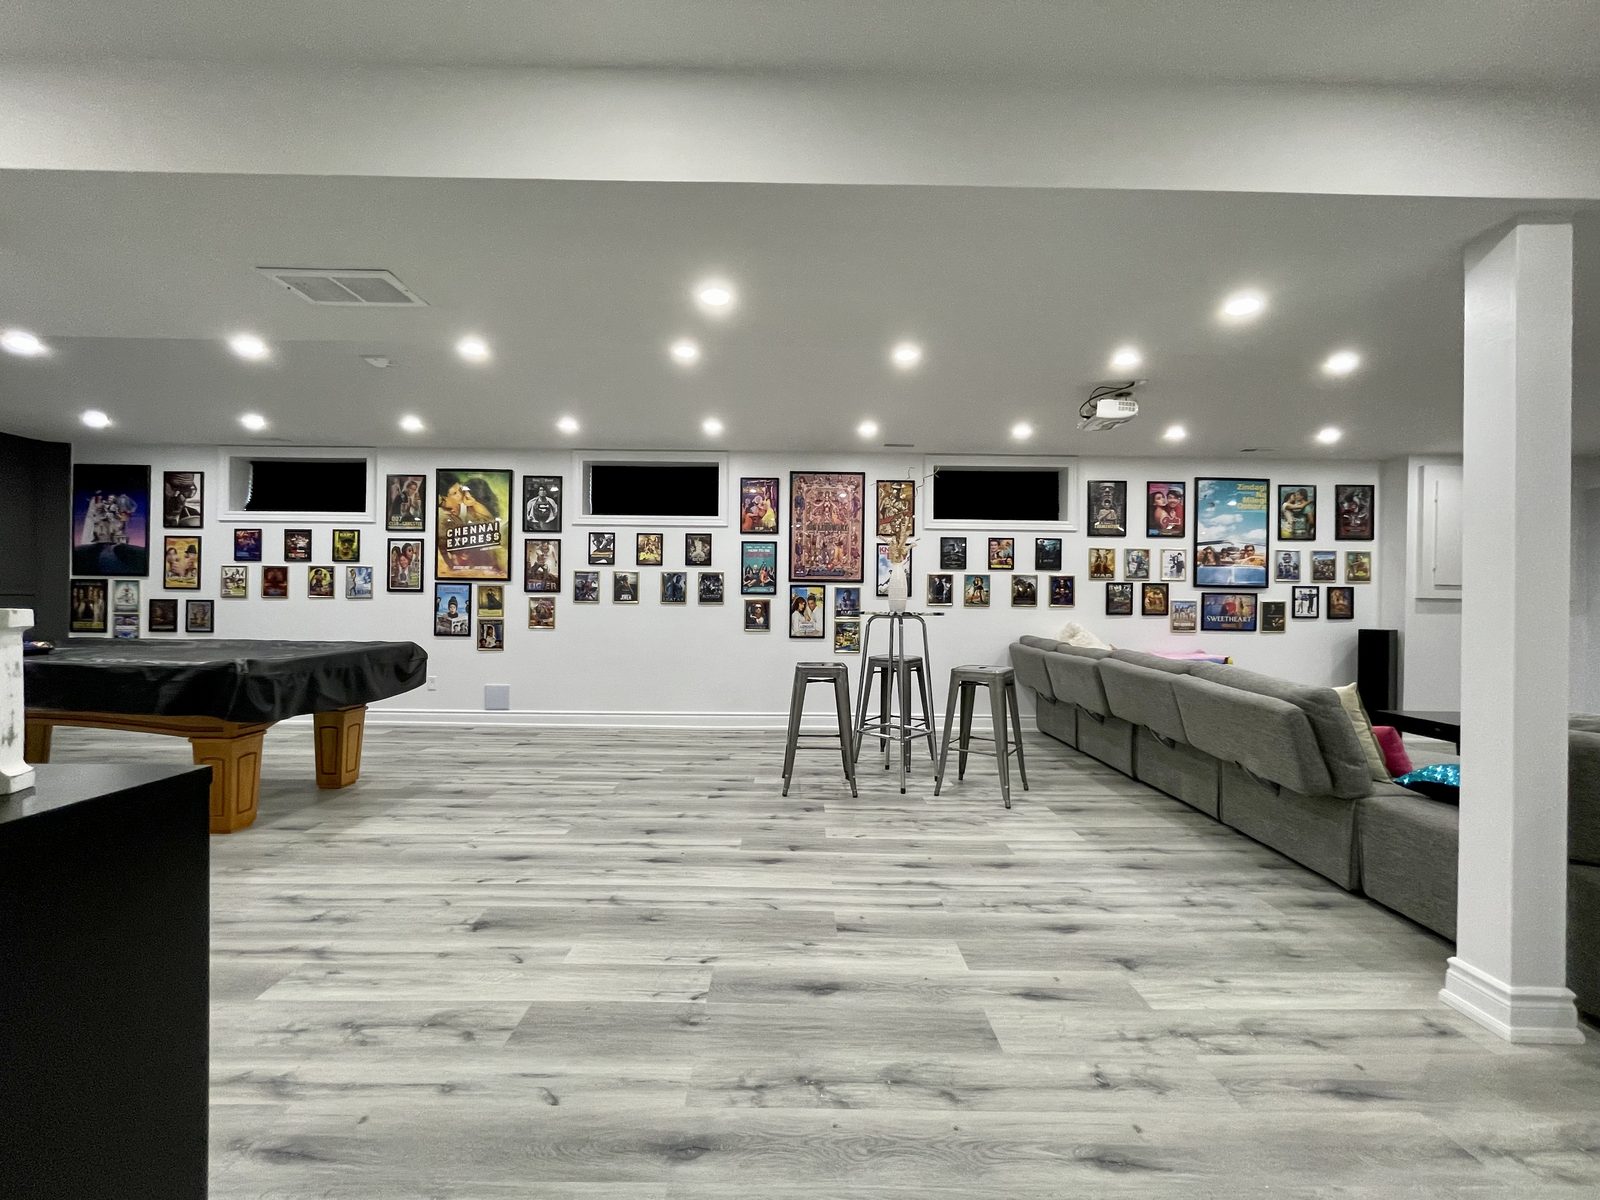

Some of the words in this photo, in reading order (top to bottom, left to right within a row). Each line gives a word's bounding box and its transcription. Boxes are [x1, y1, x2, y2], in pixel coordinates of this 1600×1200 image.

[447, 521, 499, 538] CHENNAI
[447, 532, 500, 548] EXPRESS
[1206, 615, 1252, 623] SWEETHEART
